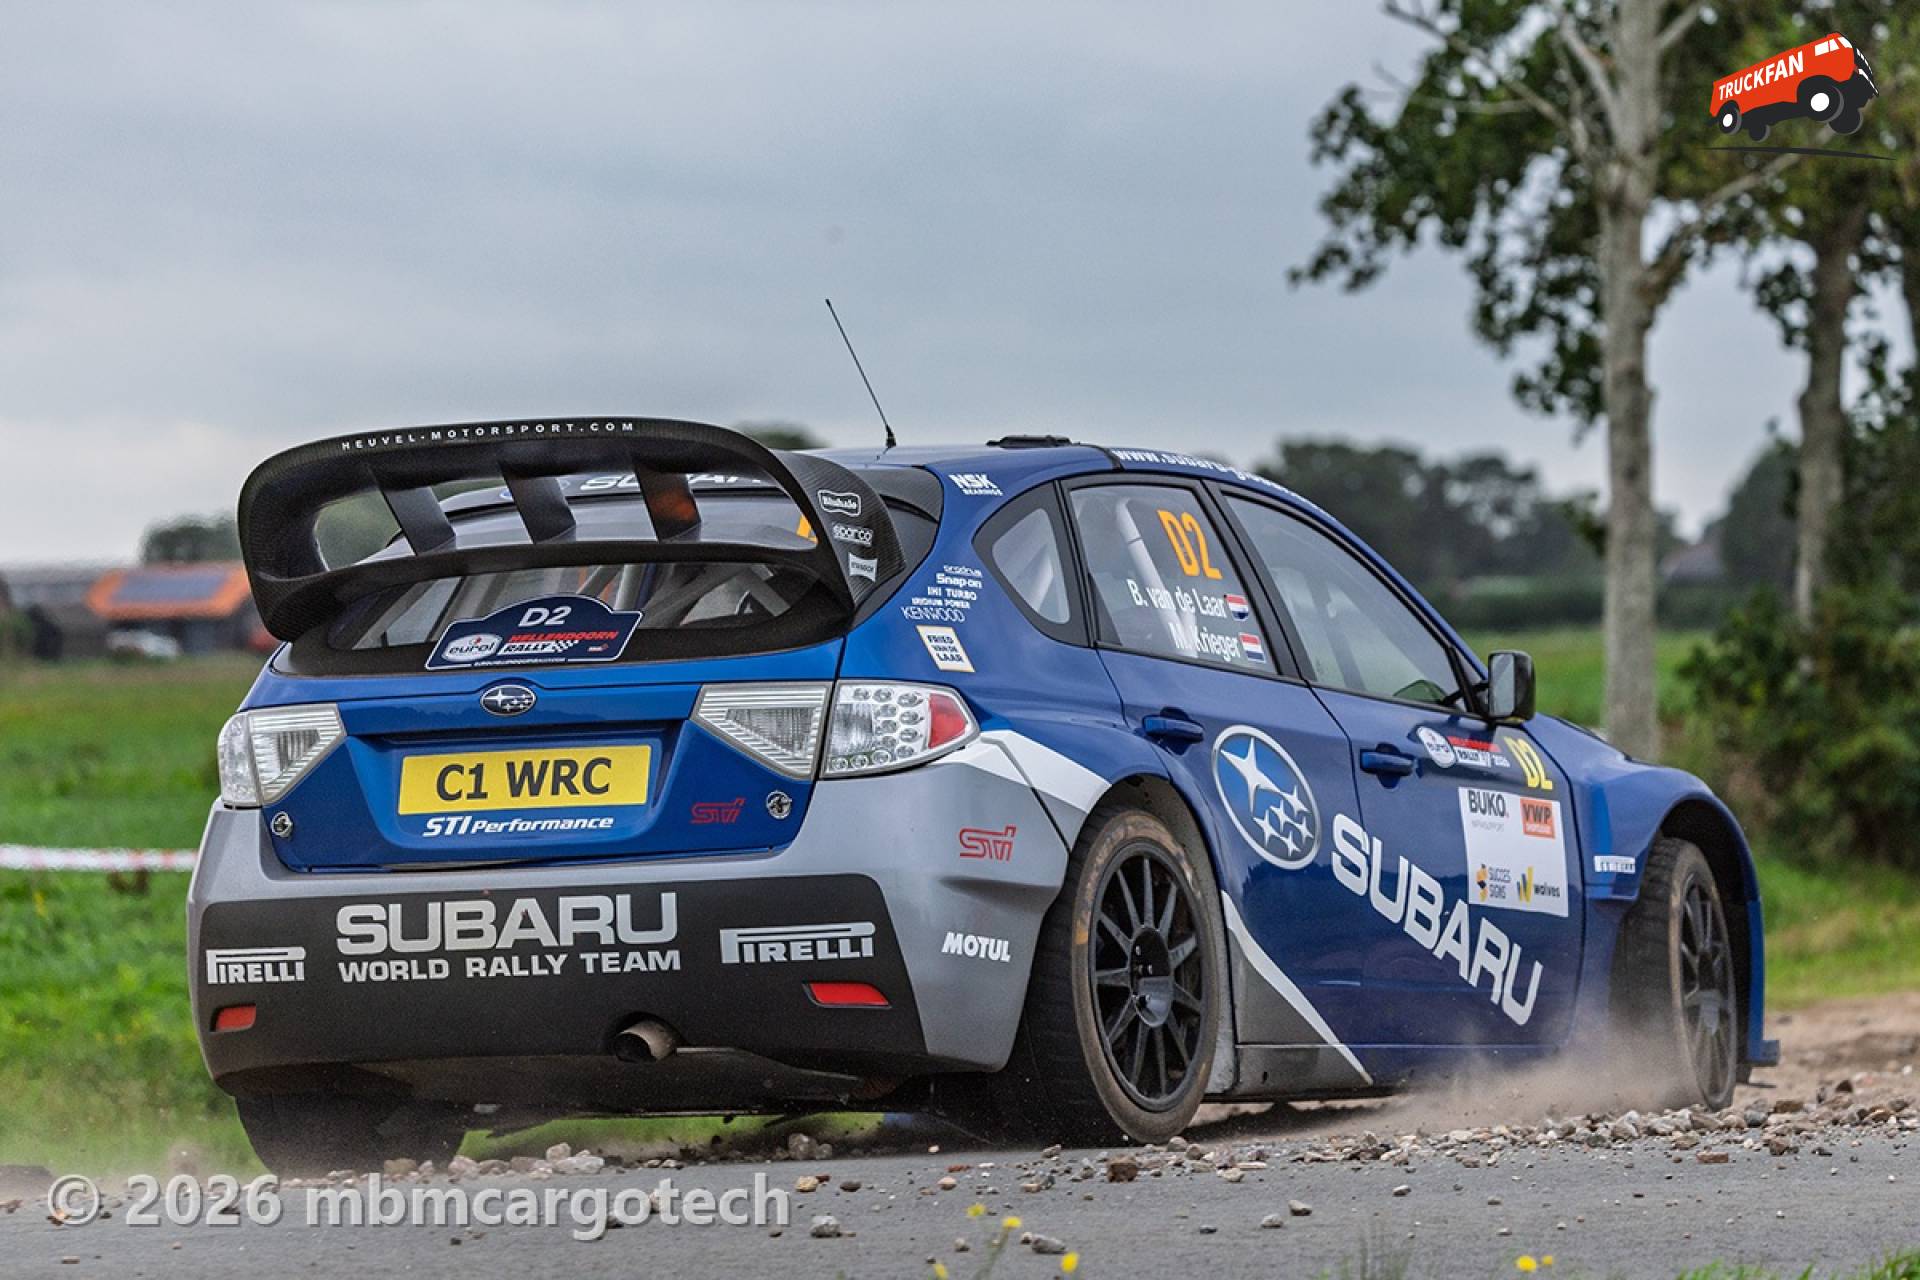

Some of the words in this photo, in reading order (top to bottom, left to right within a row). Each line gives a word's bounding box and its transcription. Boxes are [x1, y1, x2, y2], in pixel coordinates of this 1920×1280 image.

[342, 422, 633, 451] HEUVEL-MOTORSPORT.COM
[948, 474, 998, 489] NSK
[1157, 509, 1223, 580] D2
[935, 573, 982, 589] Snap-on
[927, 586, 942, 596] IHI
[945, 588, 977, 601] TURBO
[1127, 579, 1148, 606] B.
[1146, 587, 1177, 609] van
[1176, 586, 1196, 613] de
[1192, 588, 1227, 618] Laar
[518, 605, 572, 627] D2
[901, 606, 966, 623] KENWOOD
[508, 631, 619, 643] HELLENDOORN
[450, 643, 495, 655] eurol
[504, 644, 551, 654] RALLY
[936, 652, 964, 663] LAAR
[1504, 736, 1553, 789] D2
[436, 764, 488, 801] C1
[506, 757, 612, 798] WRC
[1522, 804, 1551, 824] VWP
[423, 815, 471, 838] STI
[471, 815, 614, 835] Performance
[1533, 882, 1560, 899] wolves
[335, 892, 678, 956] SUBARU
[1331, 813, 1543, 1026] SUBARU
[720, 921, 876, 964] PIRELLI
[941, 931, 1012, 963] MOTUL
[205, 946, 307, 985] PIRELLI
[338, 959, 450, 983] WORLD
[465, 954, 569, 979] RALLY
[579, 950, 681, 974] TEAM
